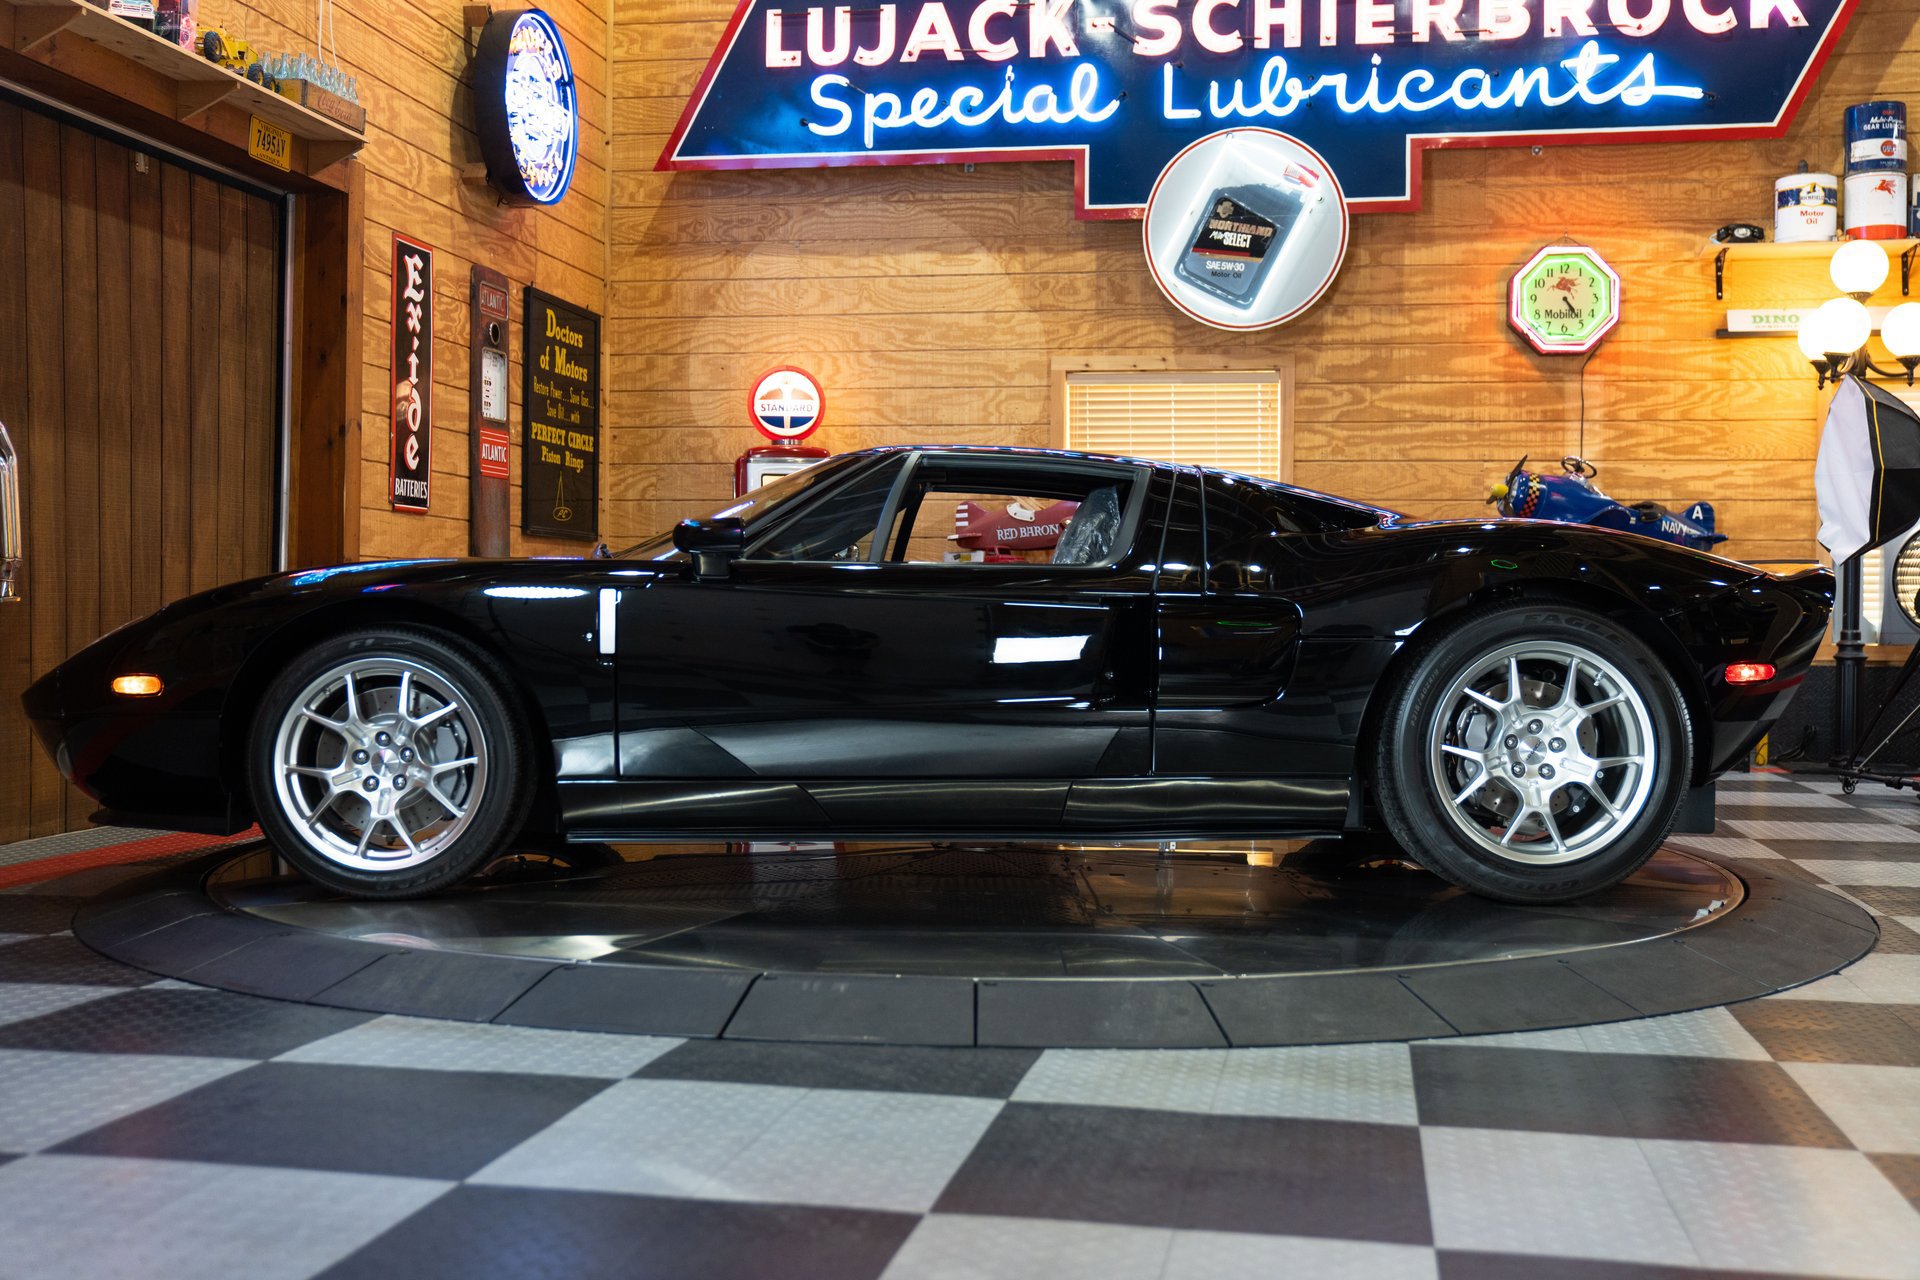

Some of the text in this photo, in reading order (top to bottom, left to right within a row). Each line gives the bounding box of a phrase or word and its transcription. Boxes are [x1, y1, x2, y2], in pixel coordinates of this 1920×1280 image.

[807, 39, 1704, 148] Special Lubricants
[1863, 123, 1880, 131] GEAR
[256, 129, 286, 158] 7495AV
[1209, 219, 1273, 237] NORTHLAND
[1205, 260, 1221, 270] SAE
[1546, 268, 1554, 278] 11
[1560, 264, 1570, 274] 12
[1578, 267, 1582, 277] 1
[1534, 279, 1545, 289] 10
[1588, 277, 1595, 288] 2
[480, 288, 506, 312] ATLANTIC
[1530, 294, 1537, 304] 9
[1592, 293, 1599, 304] 3
[1533, 309, 1541, 320] 8
[1588, 308, 1595, 319] 4
[1751, 313, 1800, 325] DINO
[546, 308, 583, 348] Doctors
[1546, 321, 1552, 331] 7
[1560, 324, 1568, 333] 6
[1578, 319, 1584, 330] 5
[540, 345, 550, 371] of
[554, 345, 588, 382] Motors
[533, 375, 549, 397] Restore
[570, 387, 580, 405] Save
[547, 399, 557, 418] Save
[570, 411, 580, 424] with
[531, 421, 595, 453] PERFECT CIRCLE
[481, 443, 507, 463] ATLANTIC
[541, 445, 585, 474] Piston Rings
[394, 477, 428, 500] BATTERIES
[1691, 504, 1704, 520] A
[996, 523, 1060, 541] RED BARON
[1661, 519, 1688, 537] NAVY
[1521, 613, 1625, 646] EAGLE
